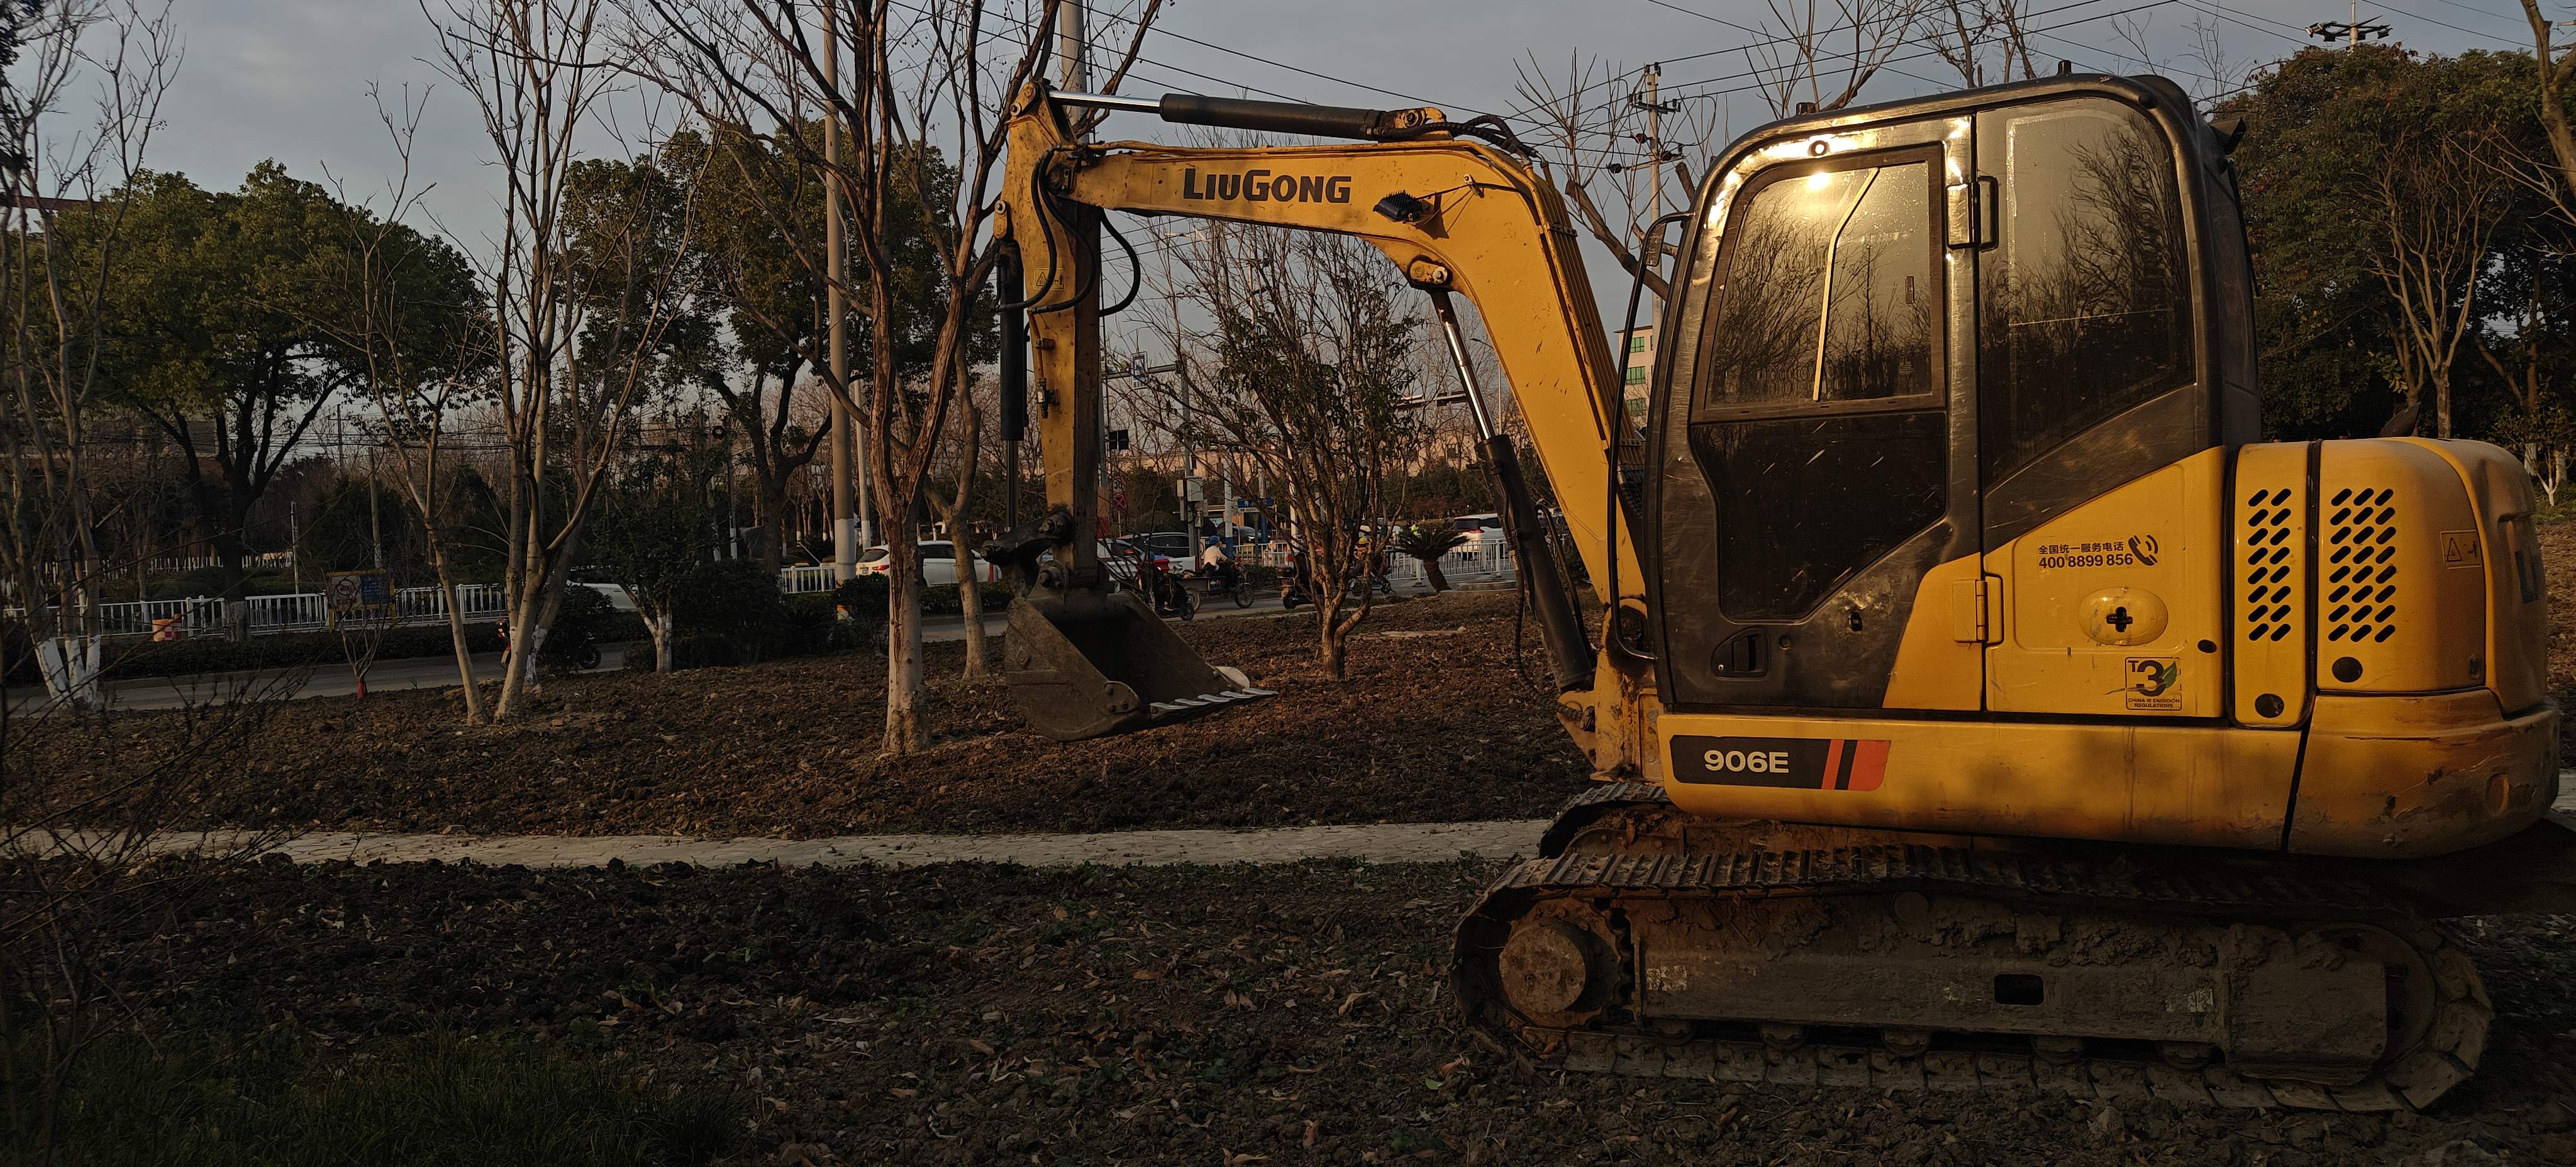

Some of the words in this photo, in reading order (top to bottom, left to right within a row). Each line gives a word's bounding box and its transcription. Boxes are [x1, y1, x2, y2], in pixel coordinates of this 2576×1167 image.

[2038, 541, 2124, 555] 全国统一服务电话
[2038, 556, 2065, 568] 400
[2068, 555, 2103, 567] 8899
[2106, 553, 2133, 566] 856
[1704, 749, 1790, 773] 906E
